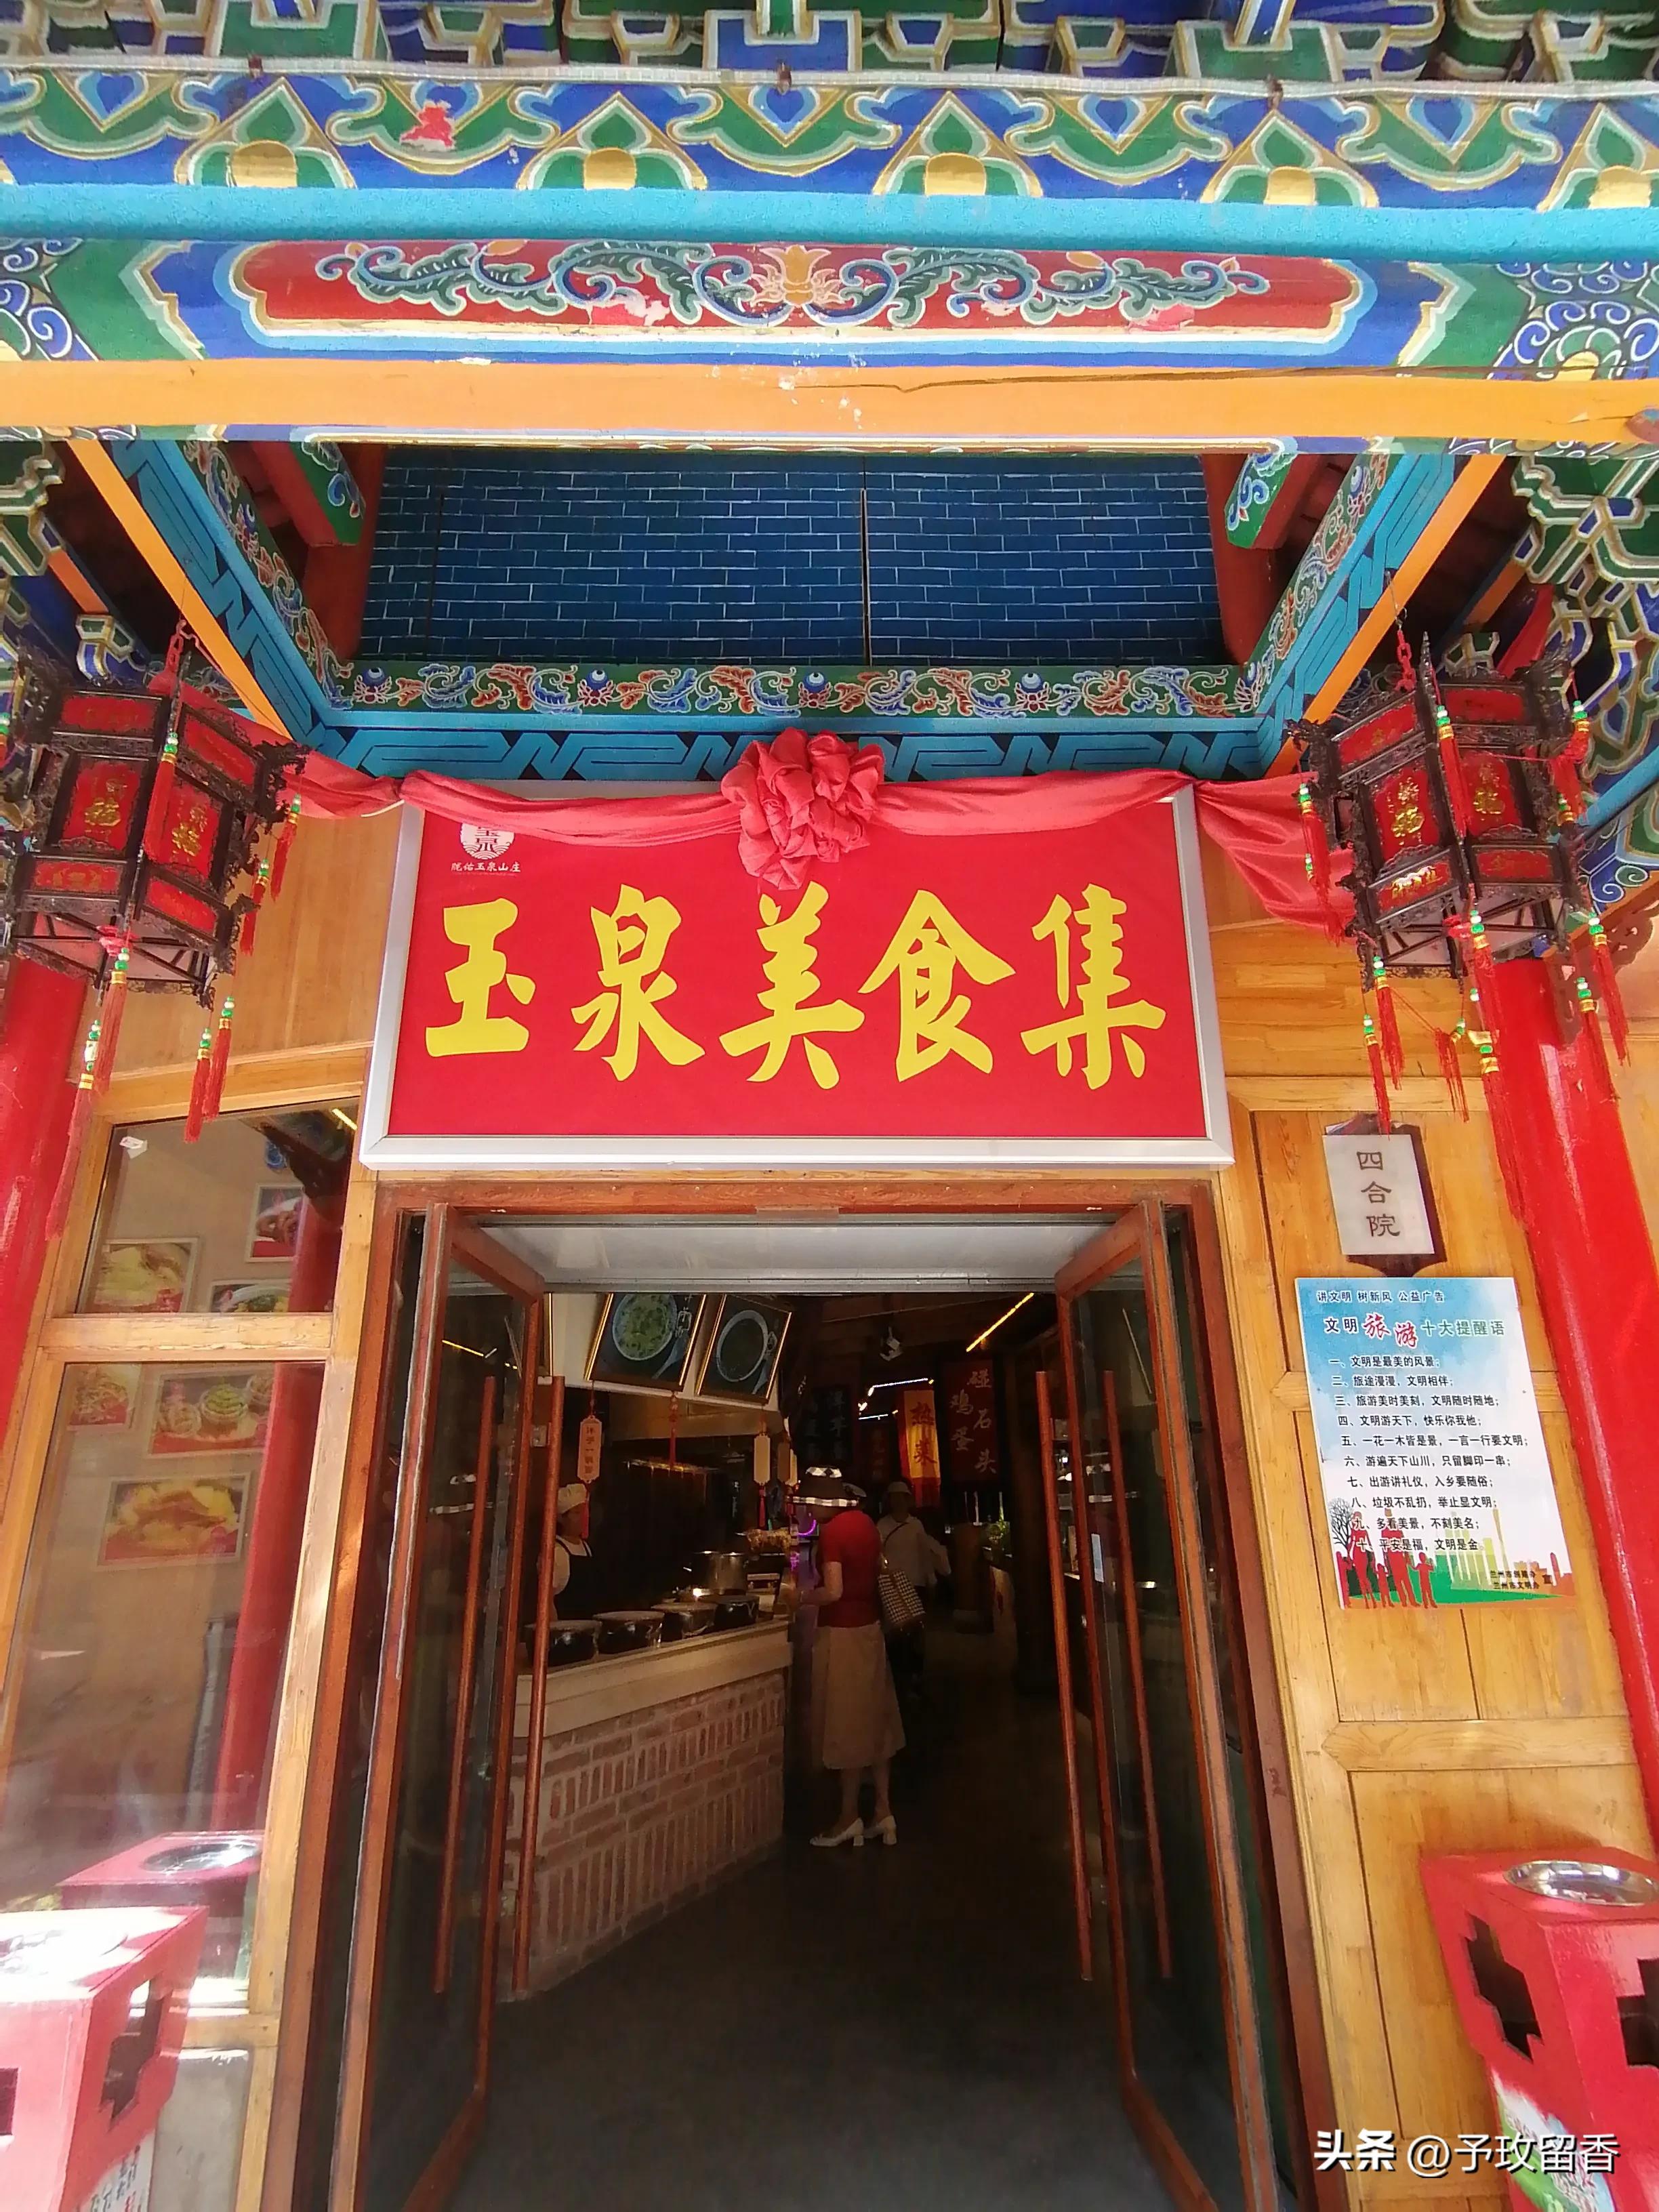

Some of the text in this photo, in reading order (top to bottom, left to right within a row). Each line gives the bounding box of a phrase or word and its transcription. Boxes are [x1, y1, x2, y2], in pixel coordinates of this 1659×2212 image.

[425, 882, 1166, 1090] 玉泉美食集
[1356, 1151, 1400, 1237] 四合院
[1317, 1291, 1445, 1302] 讲文明 树新风 公益广告
[1325, 1313, 1505, 1347] 文明旅游十大提醒语
